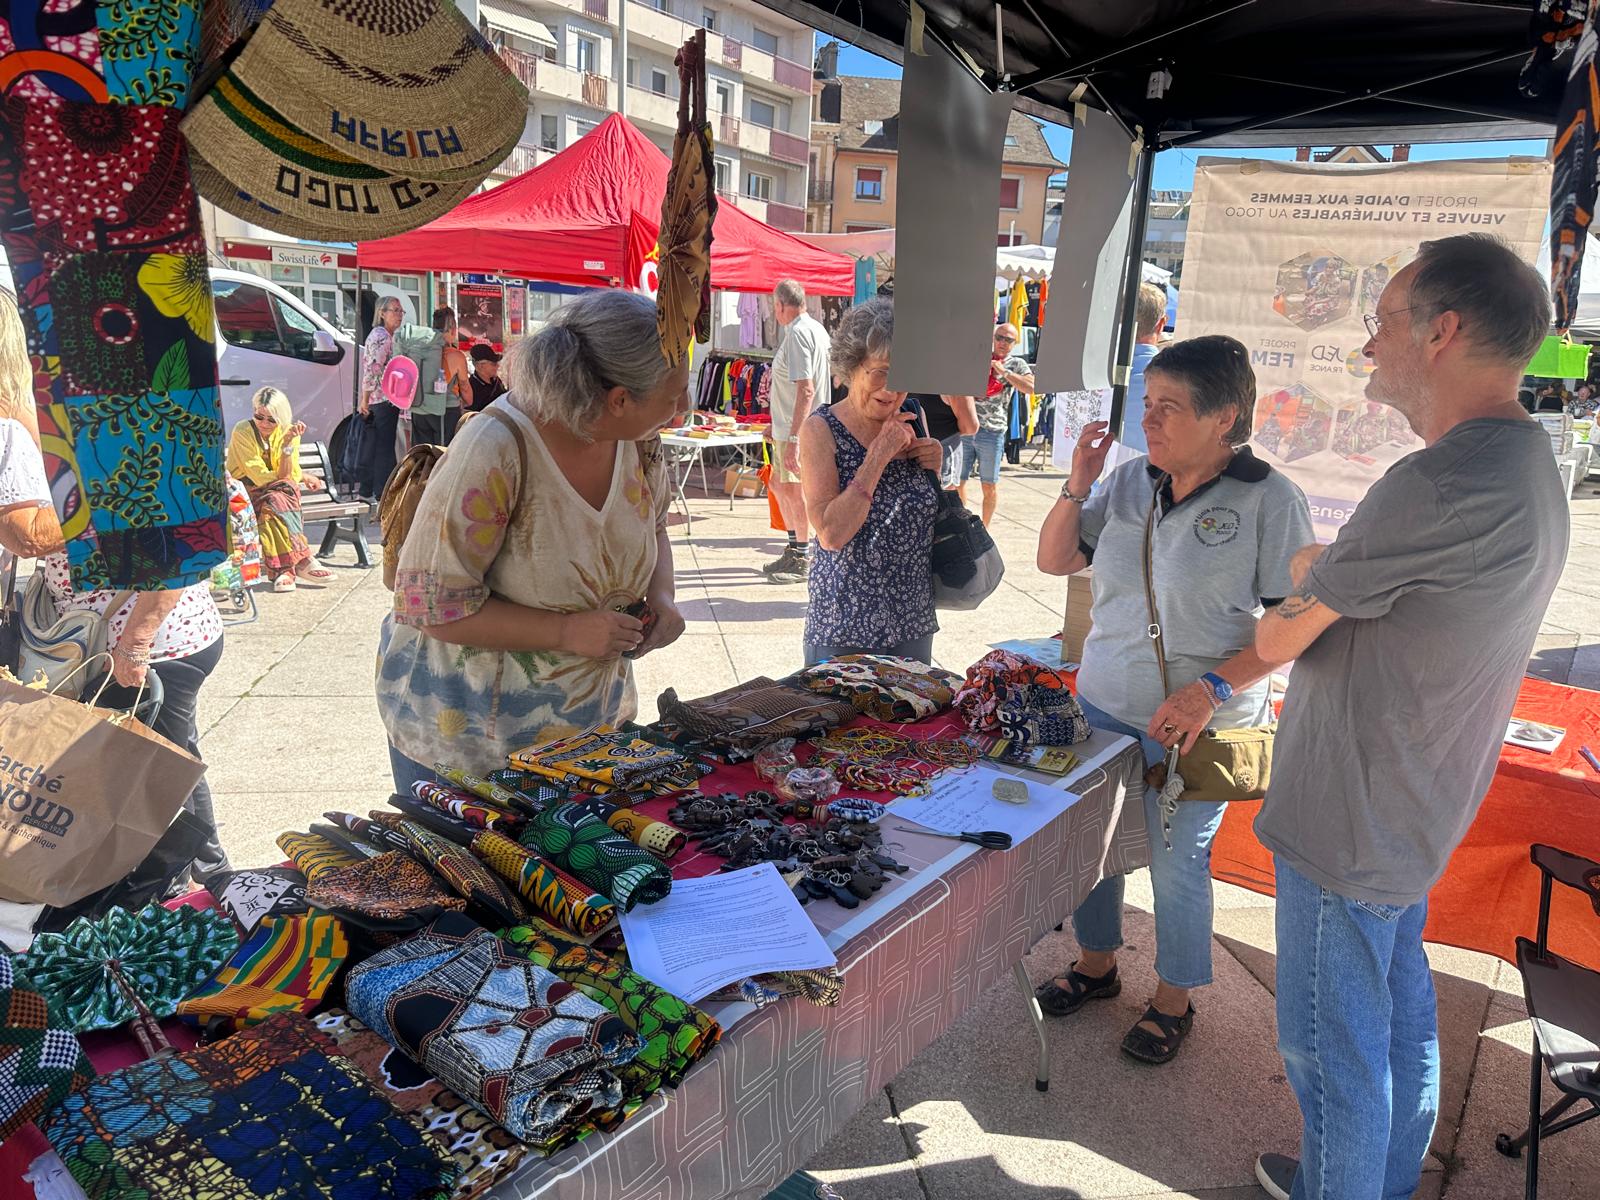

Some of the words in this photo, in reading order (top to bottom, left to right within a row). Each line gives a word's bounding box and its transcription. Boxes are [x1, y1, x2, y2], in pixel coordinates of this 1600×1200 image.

[276, 164, 380, 214] TOGO
[0, 749, 64, 794] arché
[8, 825, 57, 850] Authentique
